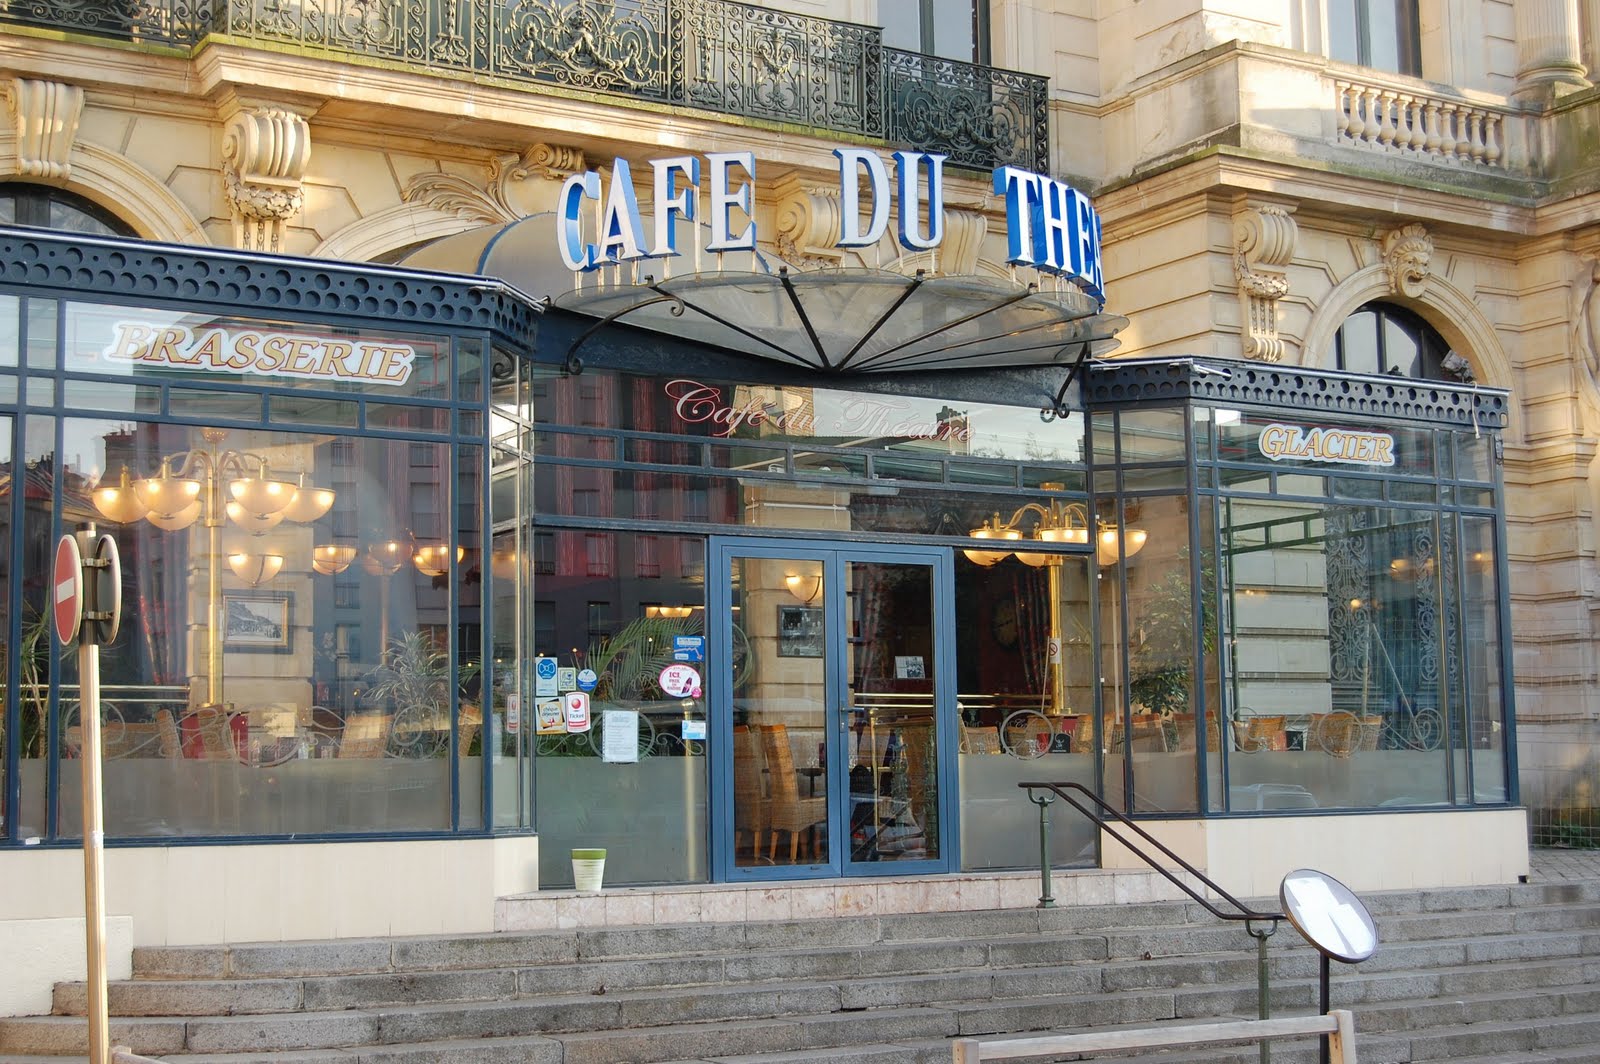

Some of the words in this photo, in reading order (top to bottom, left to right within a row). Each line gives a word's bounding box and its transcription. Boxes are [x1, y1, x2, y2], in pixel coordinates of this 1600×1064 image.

[556, 151, 756, 273] CAFE
[832, 148, 948, 251] DU
[108, 323, 412, 382] BRASSERIE
[664, 379, 778, 437] Café
[776, 399, 823, 430] du
[1261, 426, 1393, 464] GLACIER
